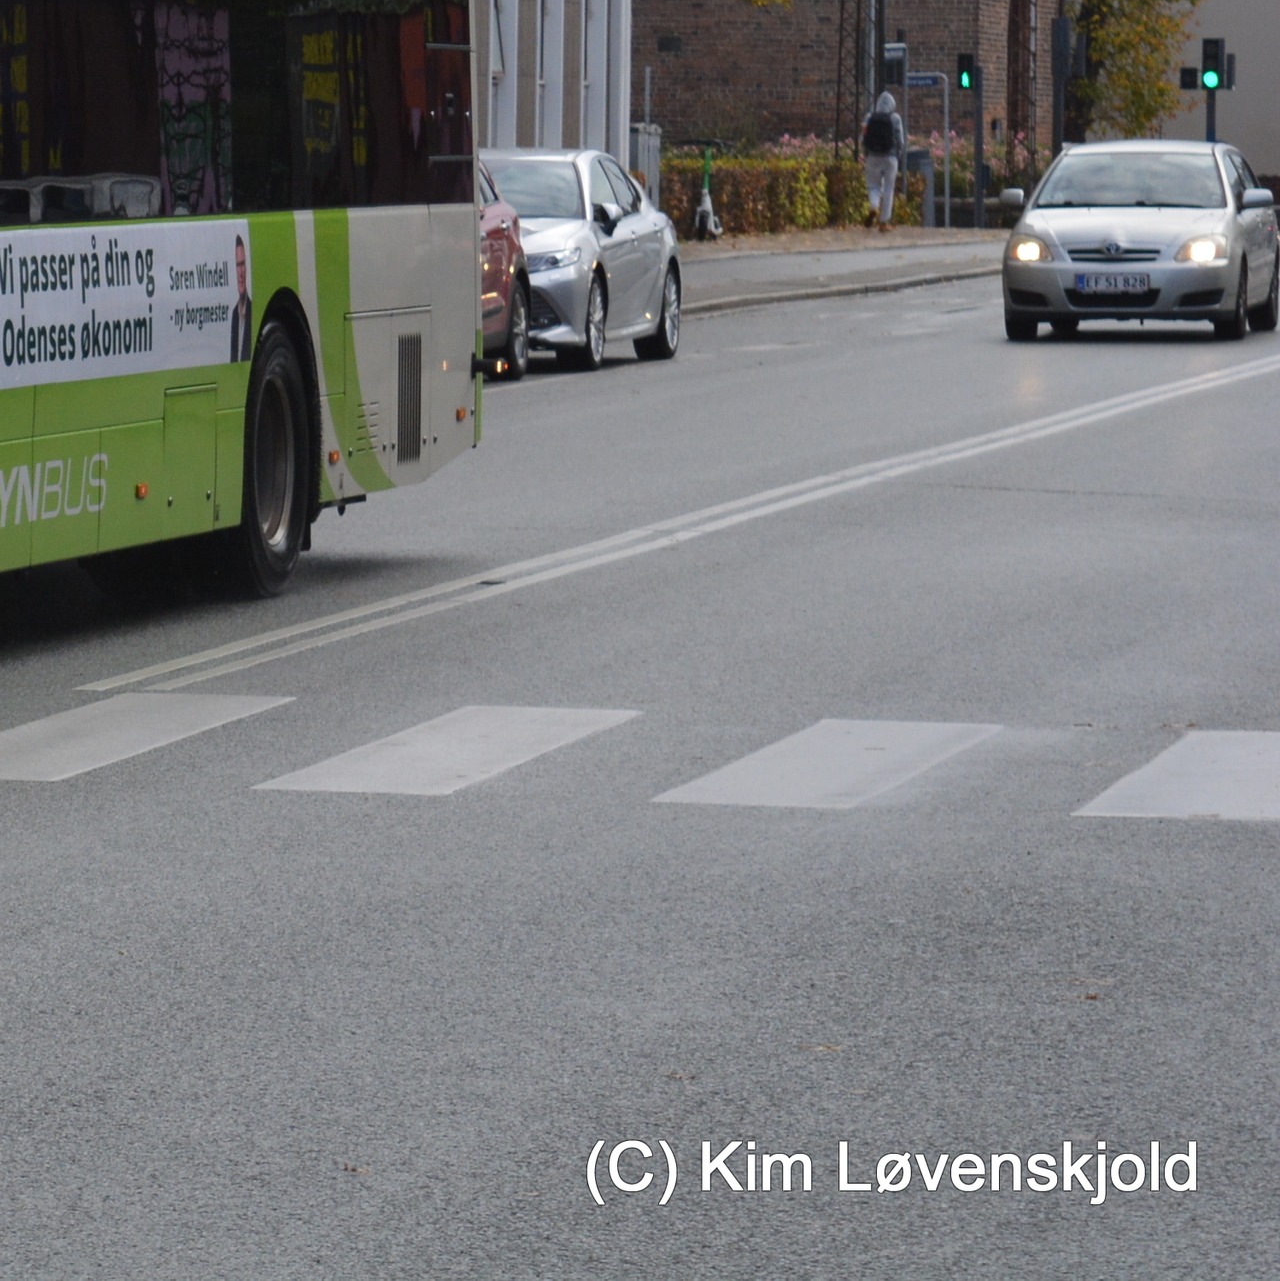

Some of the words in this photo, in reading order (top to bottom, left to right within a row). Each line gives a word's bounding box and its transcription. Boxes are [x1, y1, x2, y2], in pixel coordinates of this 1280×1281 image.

[19, 253, 75, 309] passer
[80, 234, 100, 304] på
[105, 237, 131, 288] din
[135, 248, 155, 298] og
[169, 265, 195, 291] Søren
[195, 261, 229, 289] Windell
[1123, 276, 1146, 288] 828
[174, 308, 185, 332] ny
[185, 302, 230, 331] borgmester
[2, 314, 76, 367] Odenses
[80, 303, 153, 362] økonomi
